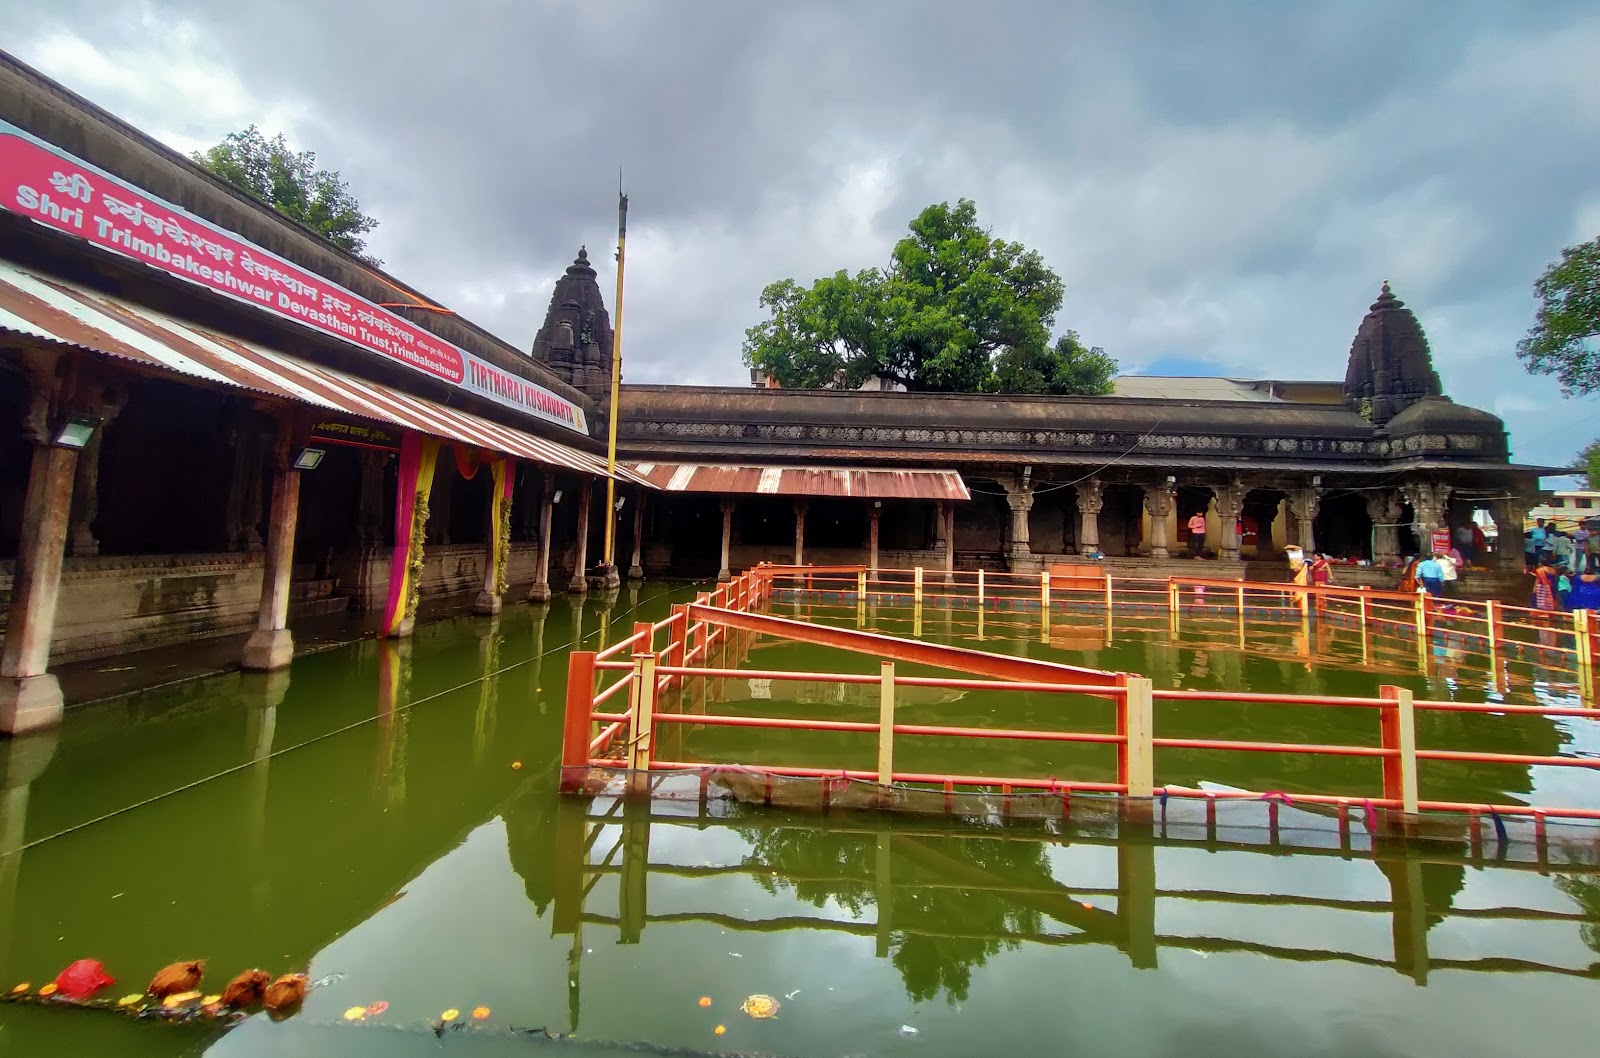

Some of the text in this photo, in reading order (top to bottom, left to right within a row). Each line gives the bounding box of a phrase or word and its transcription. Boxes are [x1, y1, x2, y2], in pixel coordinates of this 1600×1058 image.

[15, 184, 84, 229] Shri
[93, 214, 274, 303] Trimbakeshwar
[278, 292, 357, 337] Devasthan
[48, 171, 95, 204] श्री
[240, 250, 318, 302] देवस्थान
[468, 359, 524, 405] TIRTHARAJ
